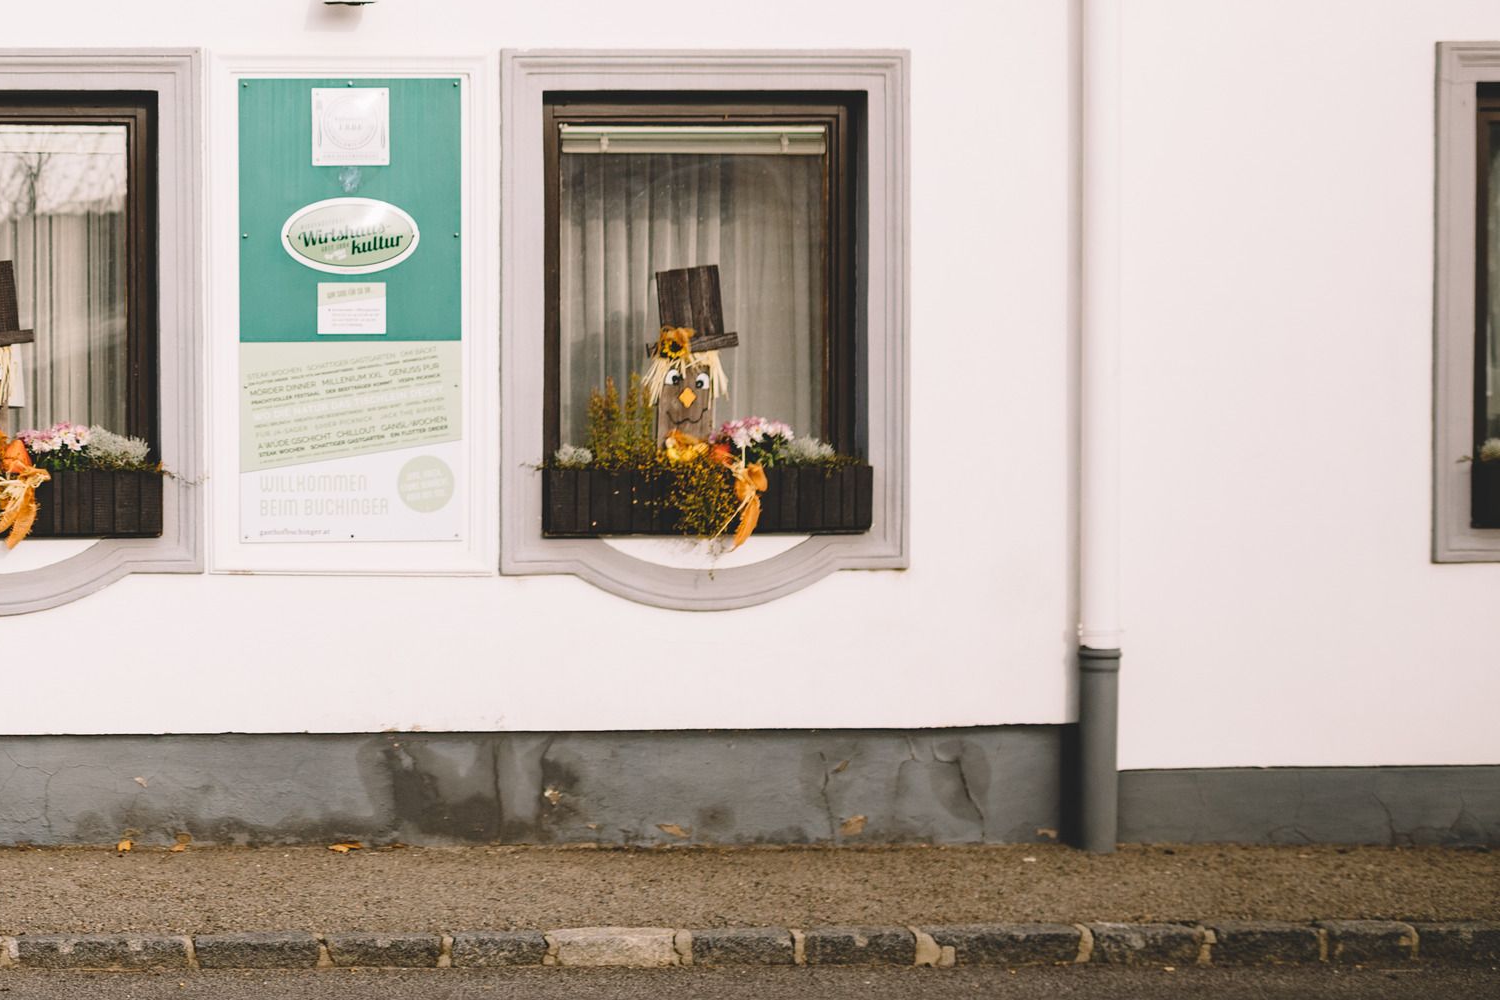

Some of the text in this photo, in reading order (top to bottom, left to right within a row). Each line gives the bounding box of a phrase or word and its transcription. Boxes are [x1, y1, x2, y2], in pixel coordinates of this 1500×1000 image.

[351, 235, 404, 256] kultur
[260, 474, 368, 493] WILLKOMMEN
[260, 498, 389, 517] BEIM BUCHINGER
